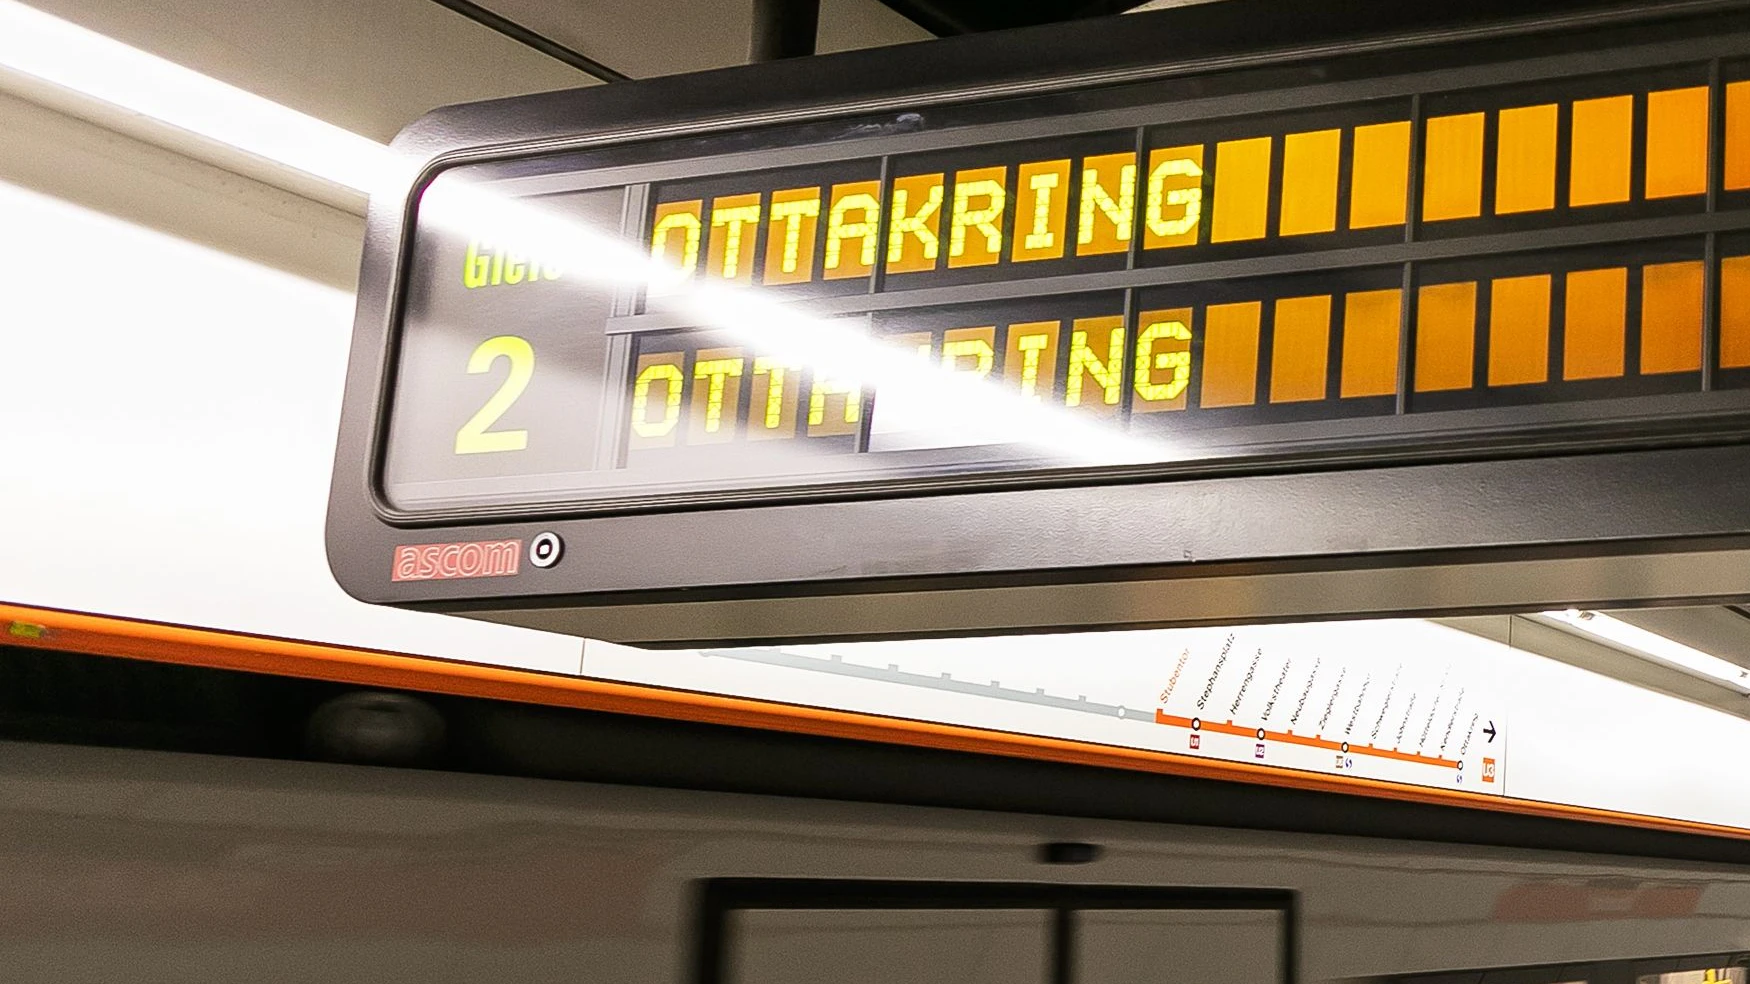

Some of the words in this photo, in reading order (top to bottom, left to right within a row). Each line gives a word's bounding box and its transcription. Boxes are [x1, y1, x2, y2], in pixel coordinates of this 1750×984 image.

[648, 157, 1203, 286] OTTAKRING
[455, 336, 535, 454] 2
[632, 320, 1193, 437] OTTARING
[400, 541, 519, 579] ascom
[1160, 648, 1190, 704] Stubentor
[1197, 633, 1235, 711] Stephansplatz
[1229, 648, 1263, 715] Herrengasse
[1483, 761, 1495, 778] U3
